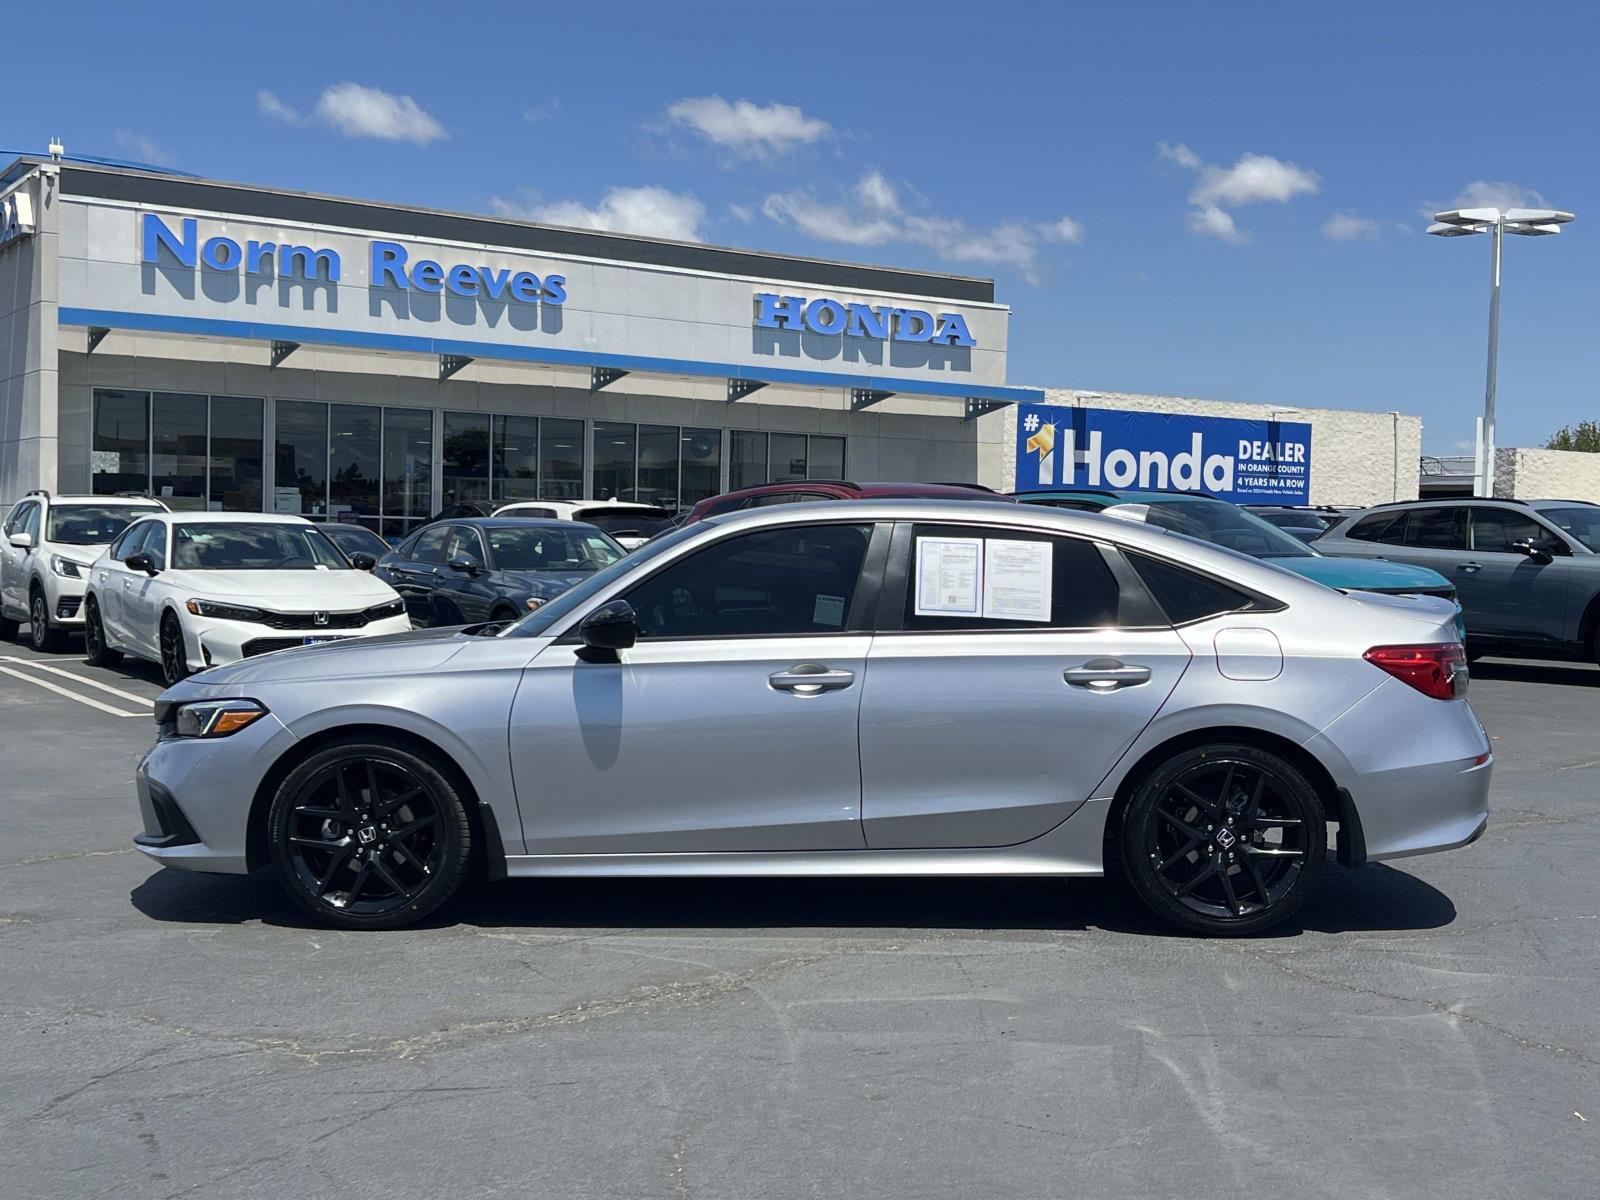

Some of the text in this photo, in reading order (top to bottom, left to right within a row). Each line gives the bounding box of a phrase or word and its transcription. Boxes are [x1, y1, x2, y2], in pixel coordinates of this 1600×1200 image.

[142, 213, 568, 306] Norm Reeves
[753, 292, 977, 347] HONDA
[1062, 428, 1235, 492] Honda
[1238, 439, 1305, 463] DEALER
[1238, 463, 1305, 474] IN ORANGE COUNTY
[1237, 477, 1305, 489] 4 YEARS IN A ROW
